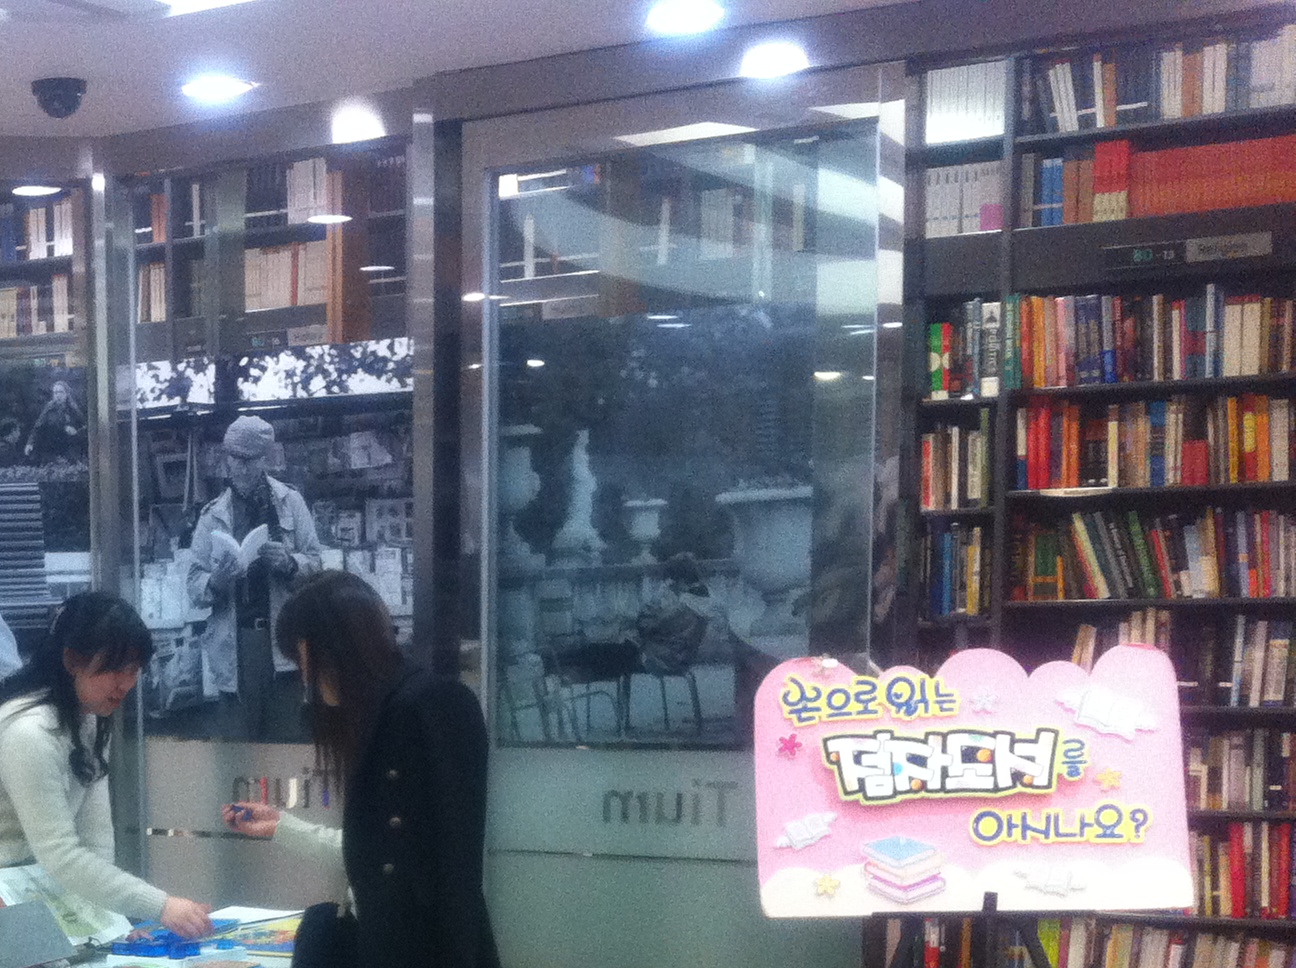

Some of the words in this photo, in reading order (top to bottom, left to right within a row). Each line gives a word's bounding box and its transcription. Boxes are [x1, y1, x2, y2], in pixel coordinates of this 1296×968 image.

[783, 677, 878, 722] 손으로
[885, 676, 958, 719] 읽는
[972, 803, 1149, 842] 아시나요?
